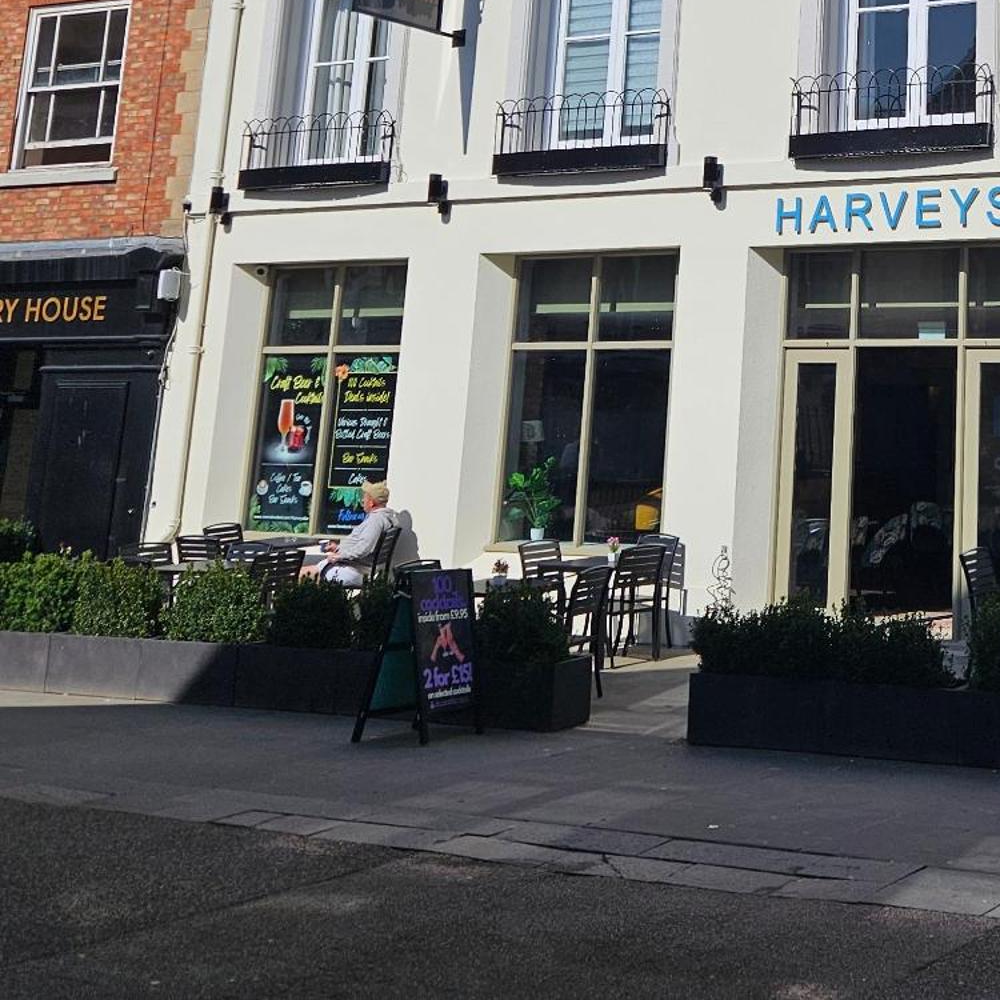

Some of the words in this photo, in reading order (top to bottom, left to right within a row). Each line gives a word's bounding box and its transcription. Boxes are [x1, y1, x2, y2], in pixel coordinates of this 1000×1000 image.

[24, 295, 108, 322] HOUSE
[270, 375, 292, 391] Craft
[293, 375, 312, 389] Beer
[417, 612, 435, 623] inside
[434, 610, 450, 622] from
[450, 607, 469, 620] £9.95
[423, 668, 434, 689] 2
[433, 666, 450, 687] for
